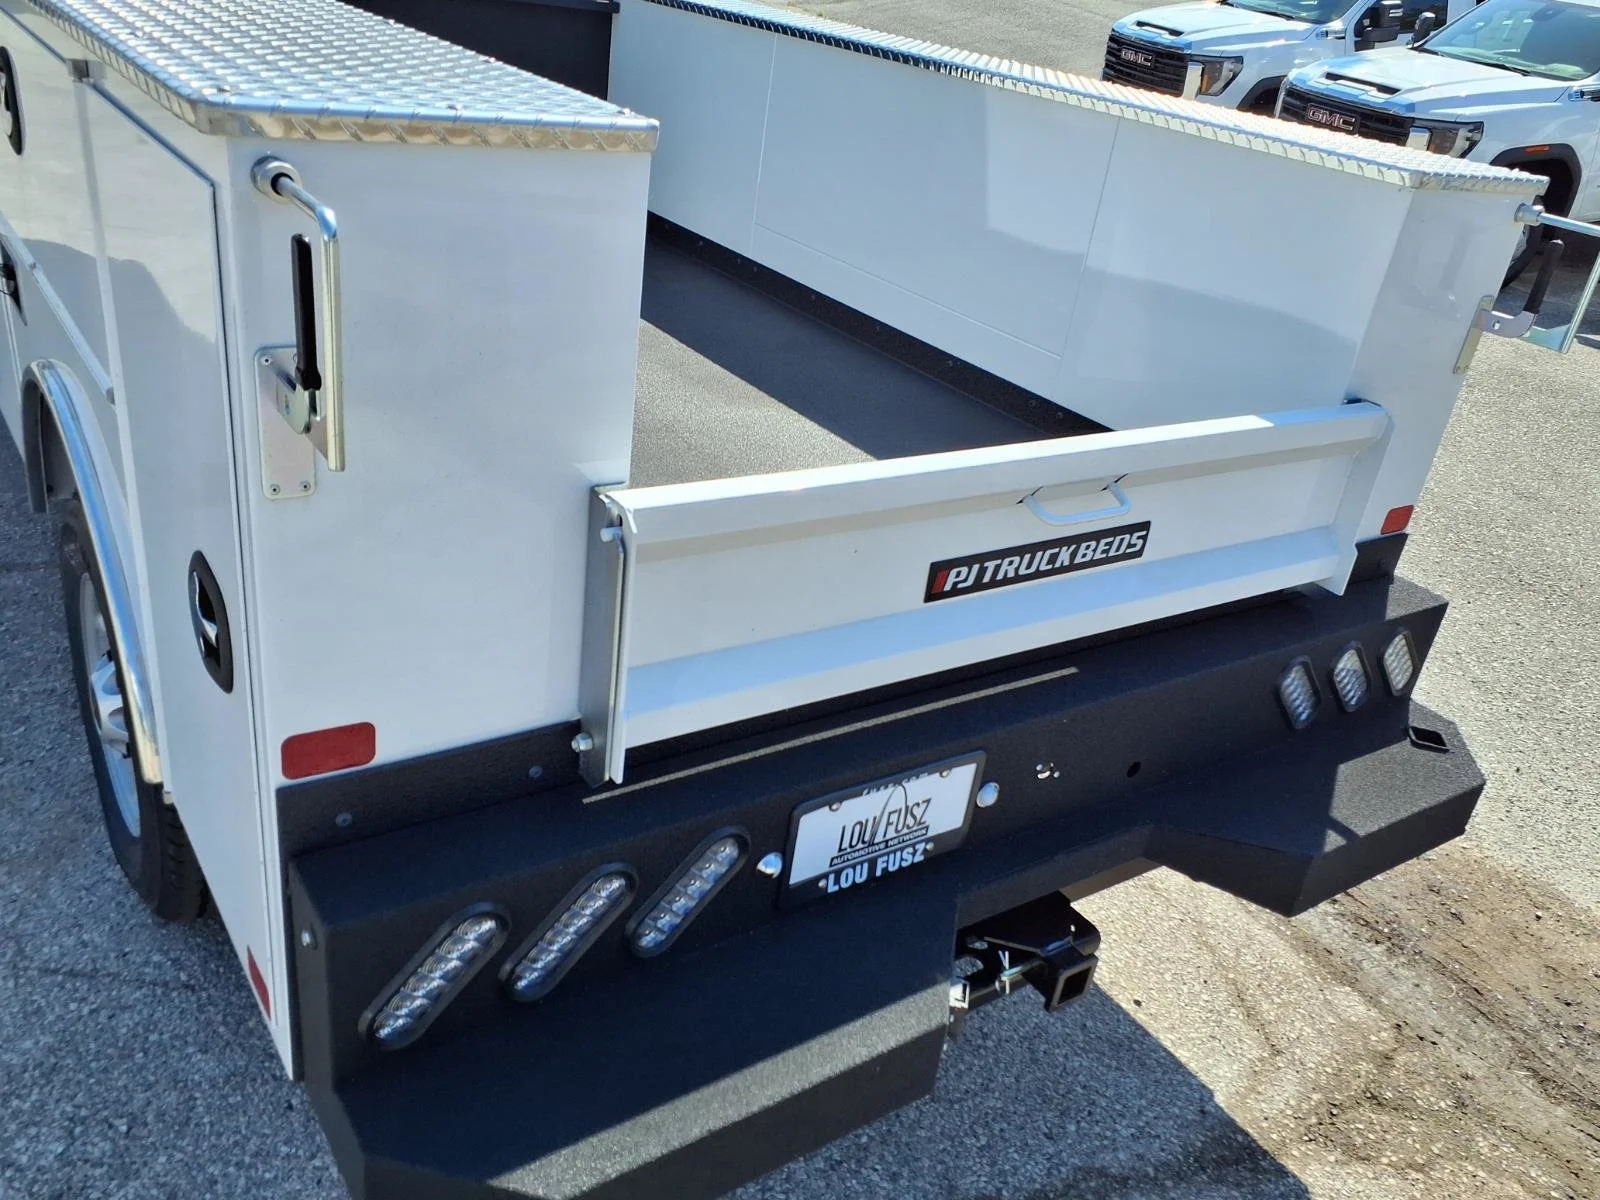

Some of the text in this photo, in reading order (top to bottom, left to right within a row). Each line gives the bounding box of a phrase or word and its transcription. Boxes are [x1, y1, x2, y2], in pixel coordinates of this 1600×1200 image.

[1120, 49, 1153, 67] GMC
[1307, 107, 1357, 131] GMC
[943, 563, 978, 592] PJ
[837, 798, 932, 854] LOU FUSZ
[831, 827, 928, 866] AUTOMOTIVE NETWORK
[827, 842, 926, 894] LOU FUSZ
